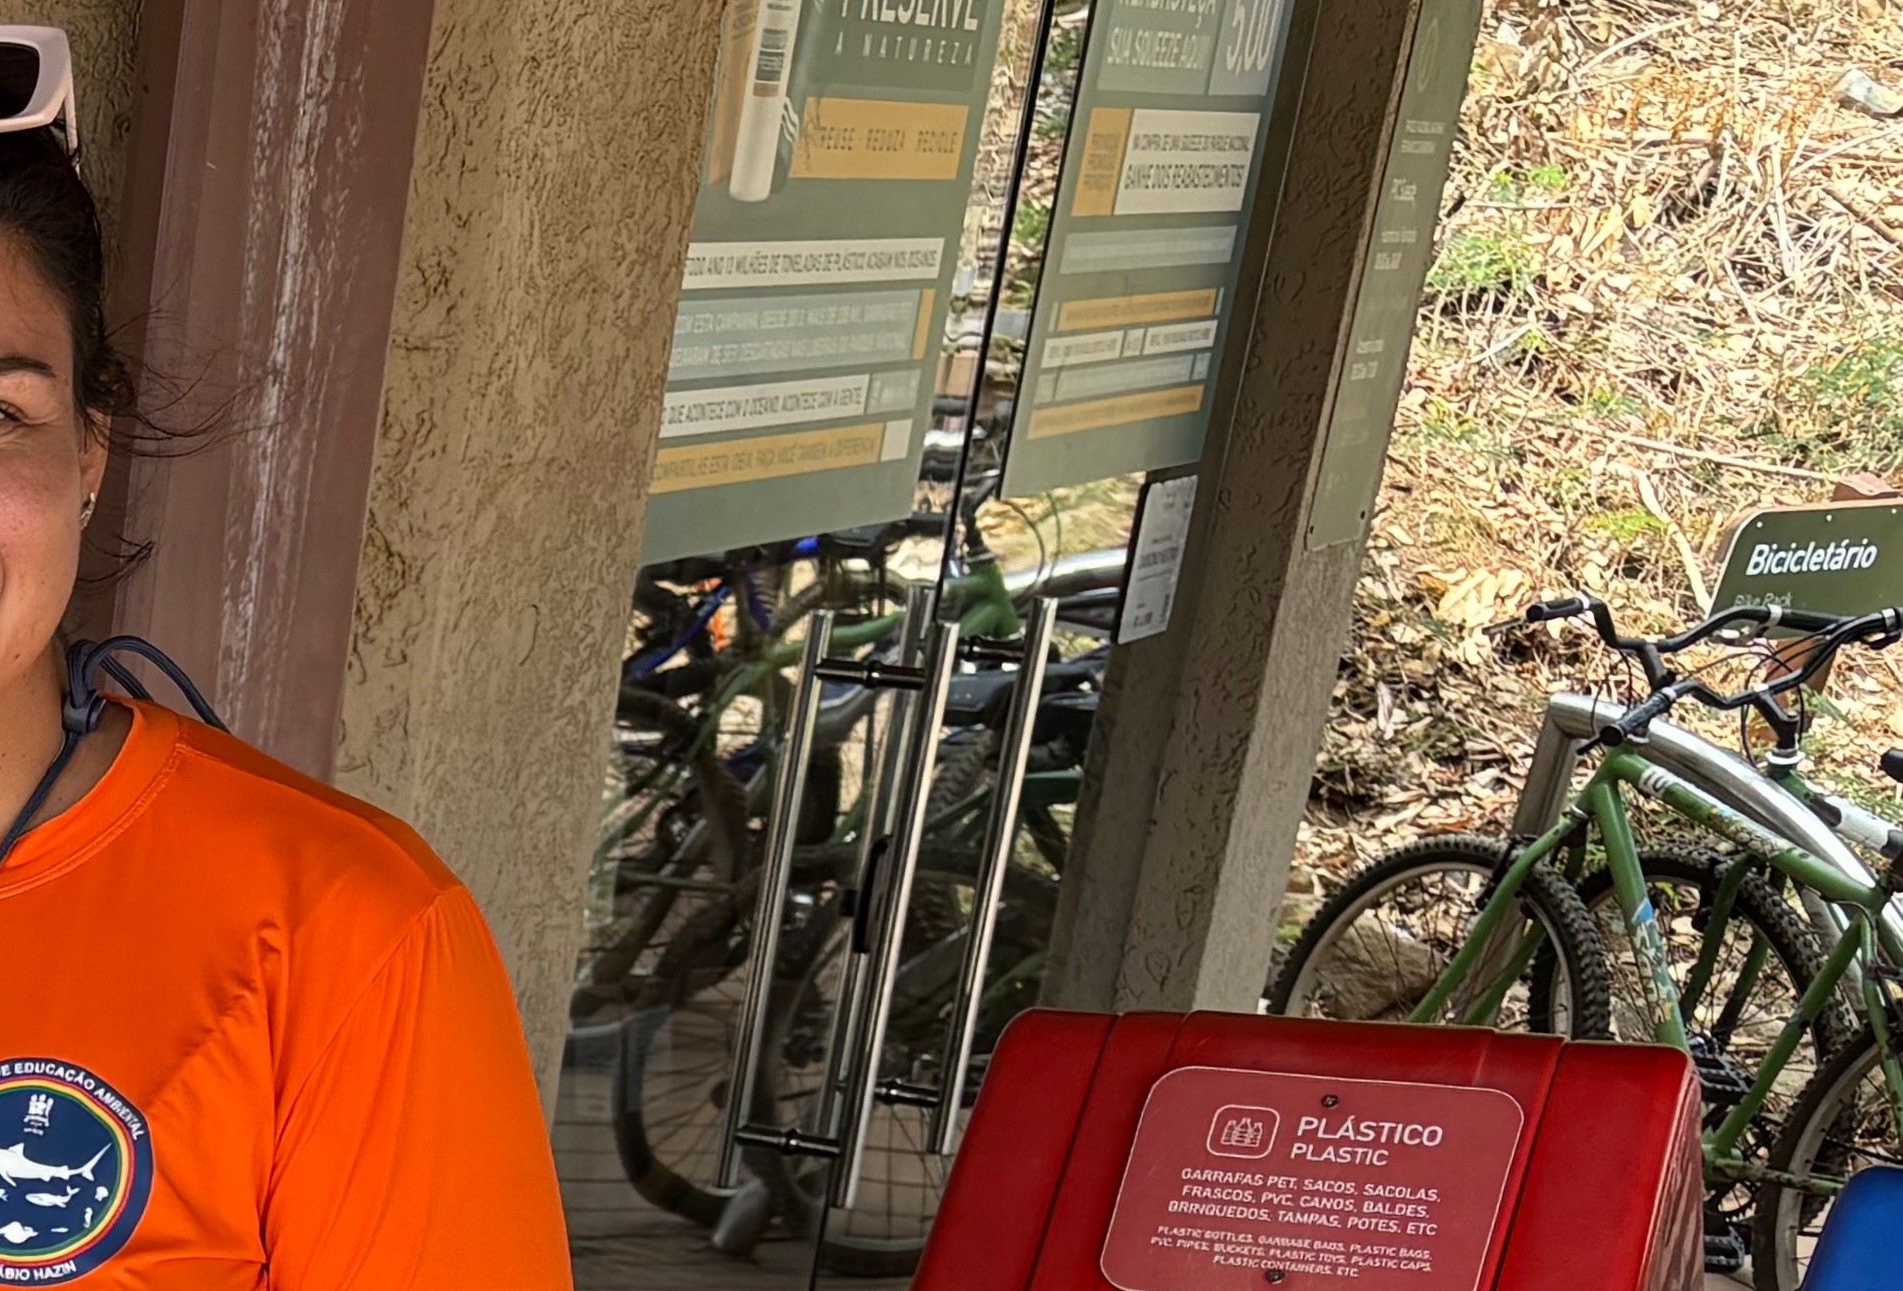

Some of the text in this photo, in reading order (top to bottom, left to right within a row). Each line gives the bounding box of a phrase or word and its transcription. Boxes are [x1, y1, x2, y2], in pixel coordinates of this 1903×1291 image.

[862, 33, 972, 65] NATUREZA
[1746, 538, 1878, 575] Bicicletário
[14, 1062, 95, 1091] EDUCAÇÃO
[1297, 1115, 1444, 1148] PLÁSTICO
[1290, 1143, 1389, 1166] PLASTIC
[1182, 1167, 1263, 1187] GARRAFAS
[1407, 1222, 1438, 1236] ETC
[1157, 1225, 1202, 1240] PLASTIC
[1349, 1244, 1397, 1257] PLASTIC
[1213, 1255, 1259, 1270] PLASTIC
[1269, 1248, 1316, 1262] PLASTIC
[1351, 1255, 1397, 1269] PLASTIC
[33, 1260, 77, 1281] HAZIN
